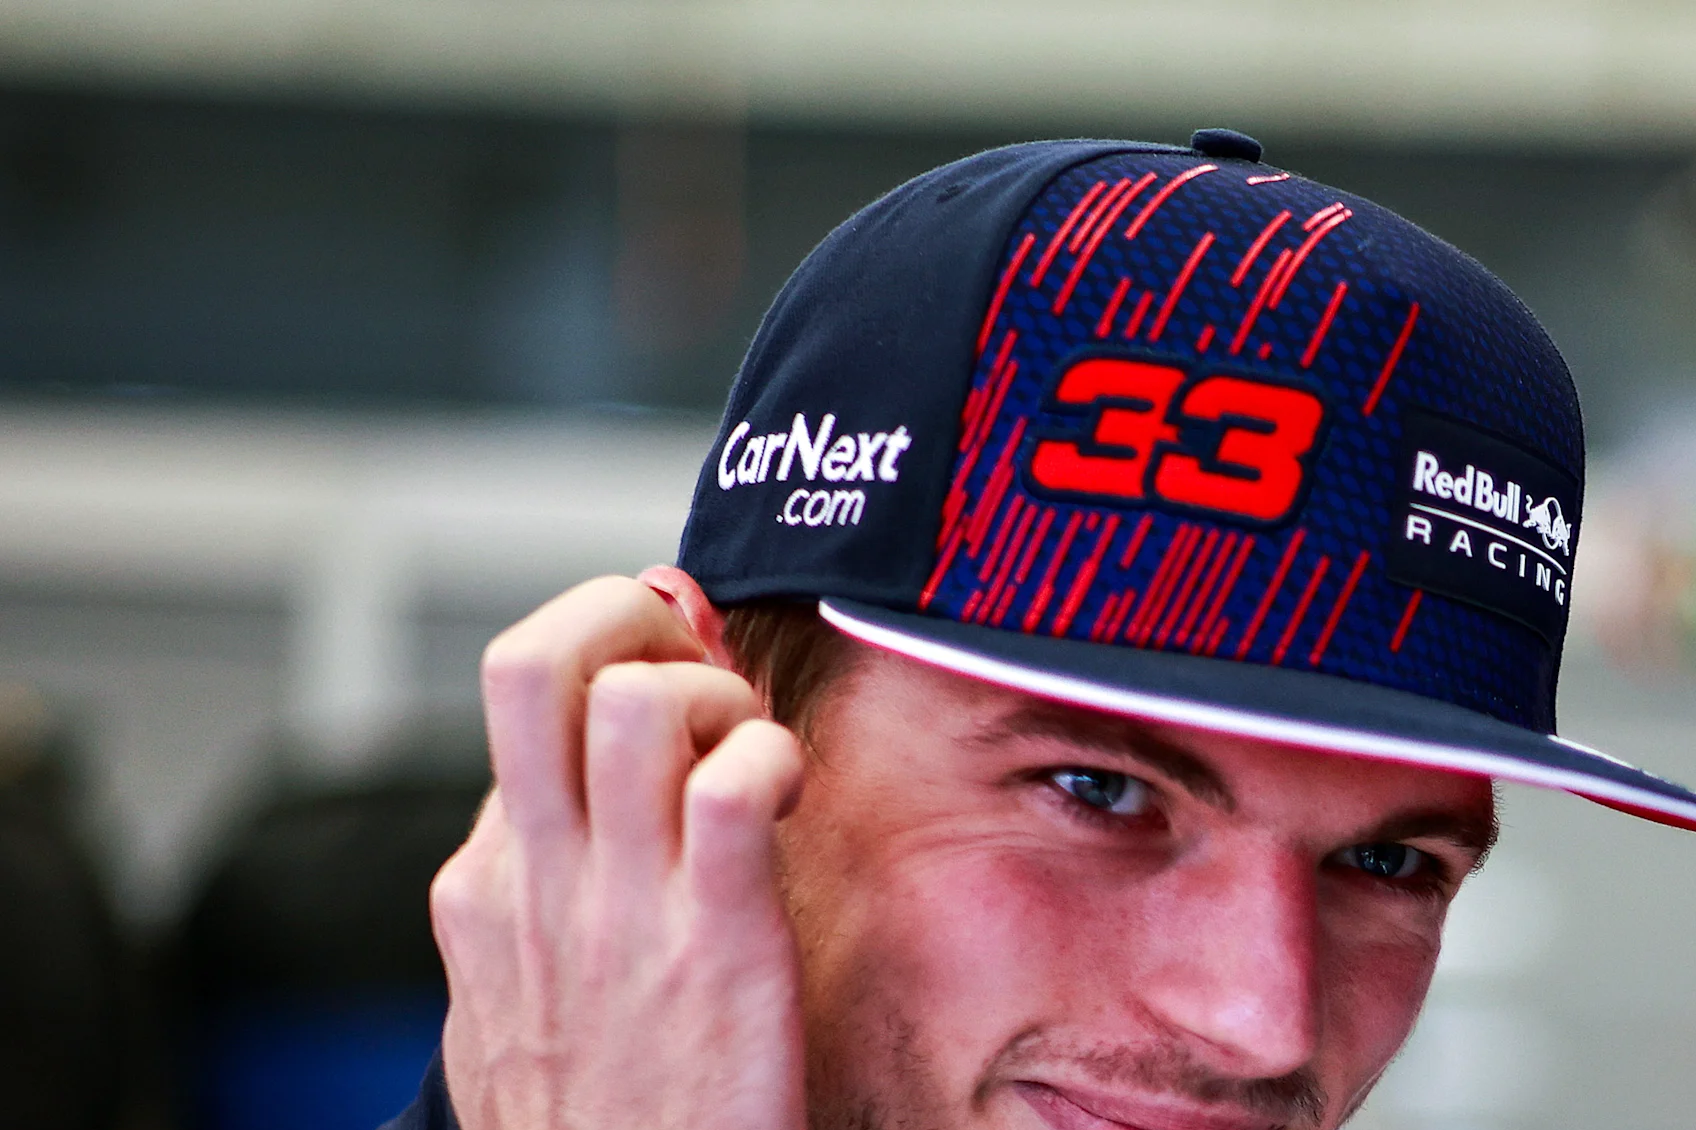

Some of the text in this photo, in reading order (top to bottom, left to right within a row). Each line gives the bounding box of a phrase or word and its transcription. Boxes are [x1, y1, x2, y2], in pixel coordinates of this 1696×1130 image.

[717, 412, 913, 491] CarNext
[1031, 358, 1324, 520] 33
[775, 488, 866, 527] .com
[1406, 513, 1566, 606] RACING
